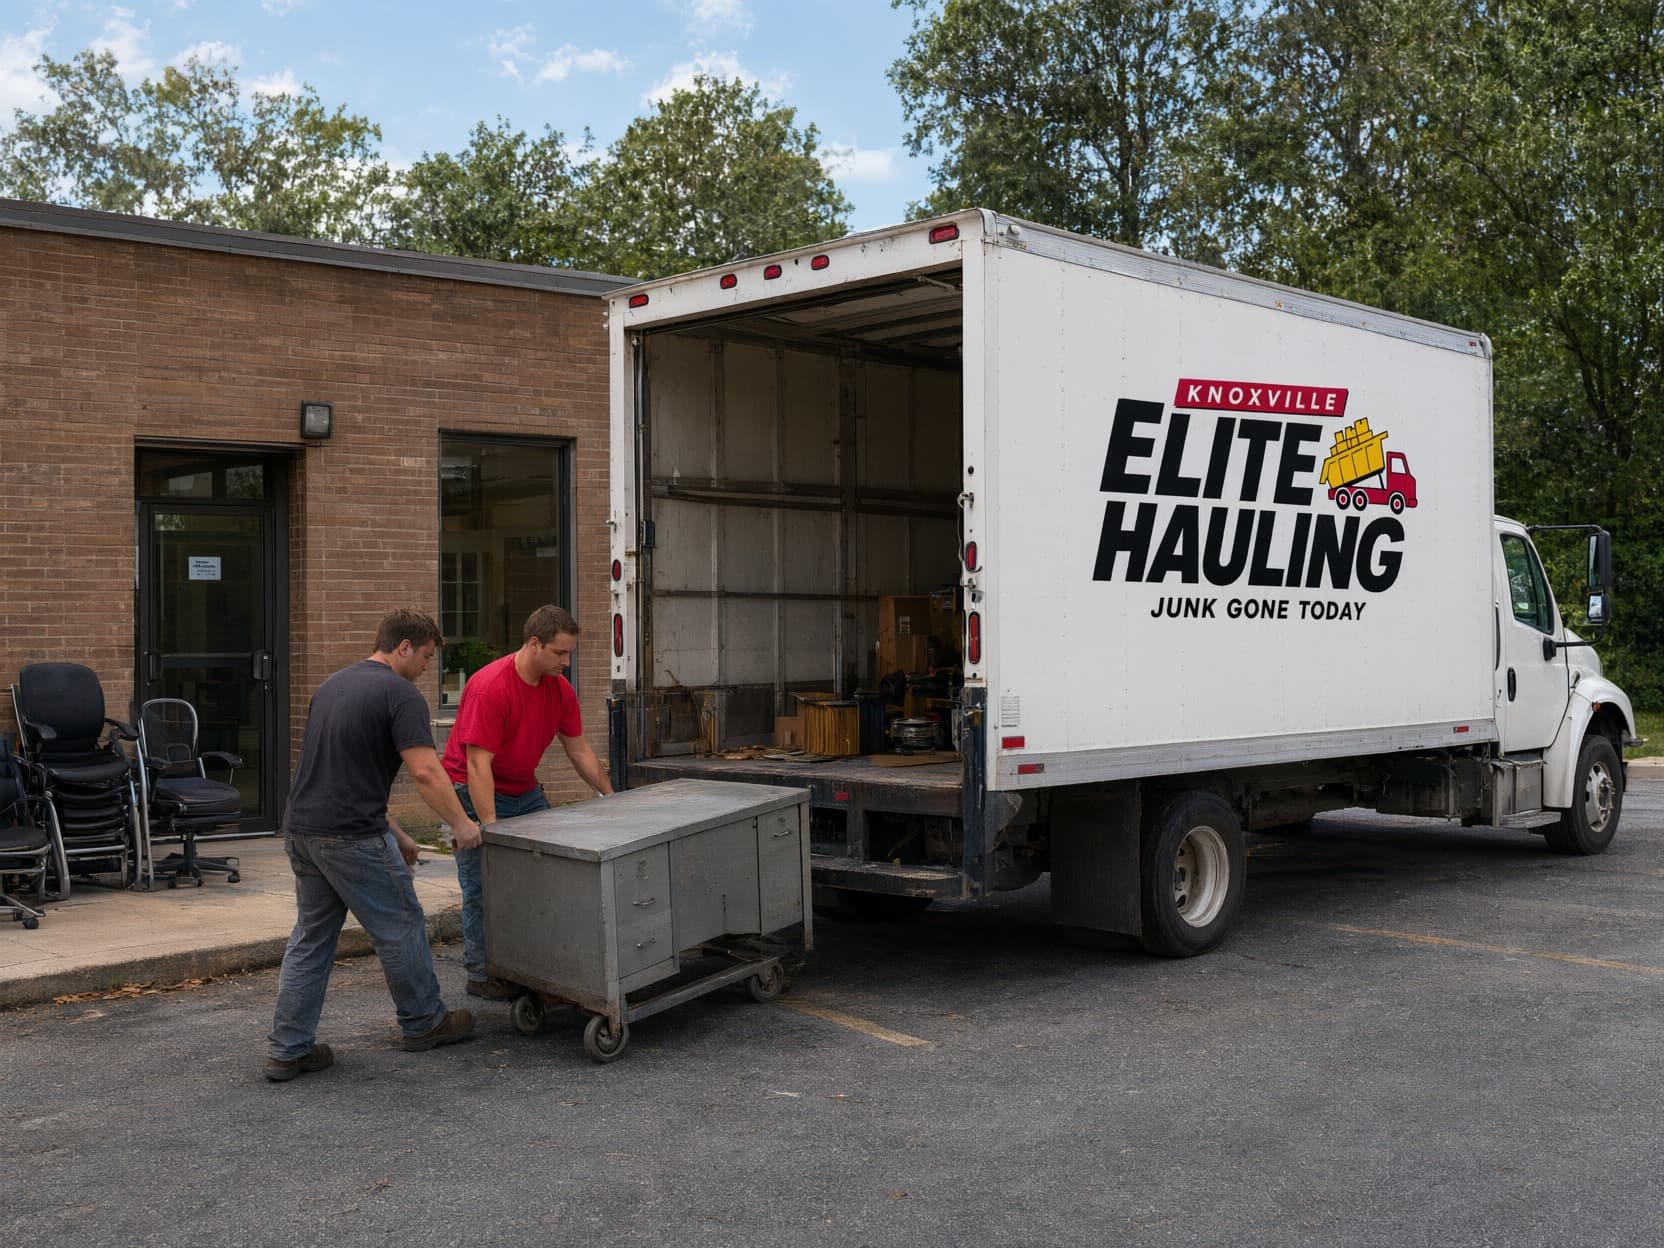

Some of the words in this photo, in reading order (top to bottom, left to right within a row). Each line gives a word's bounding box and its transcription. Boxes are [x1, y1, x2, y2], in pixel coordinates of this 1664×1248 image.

[1187, 384, 1338, 411] KNOXVILLE
[1099, 398, 1324, 507] ELITE
[1092, 500, 1406, 593] HAULING
[1150, 597, 1218, 619] JUNK
[1226, 598, 1290, 620] GONE
[1298, 600, 1367, 621] TODAY
